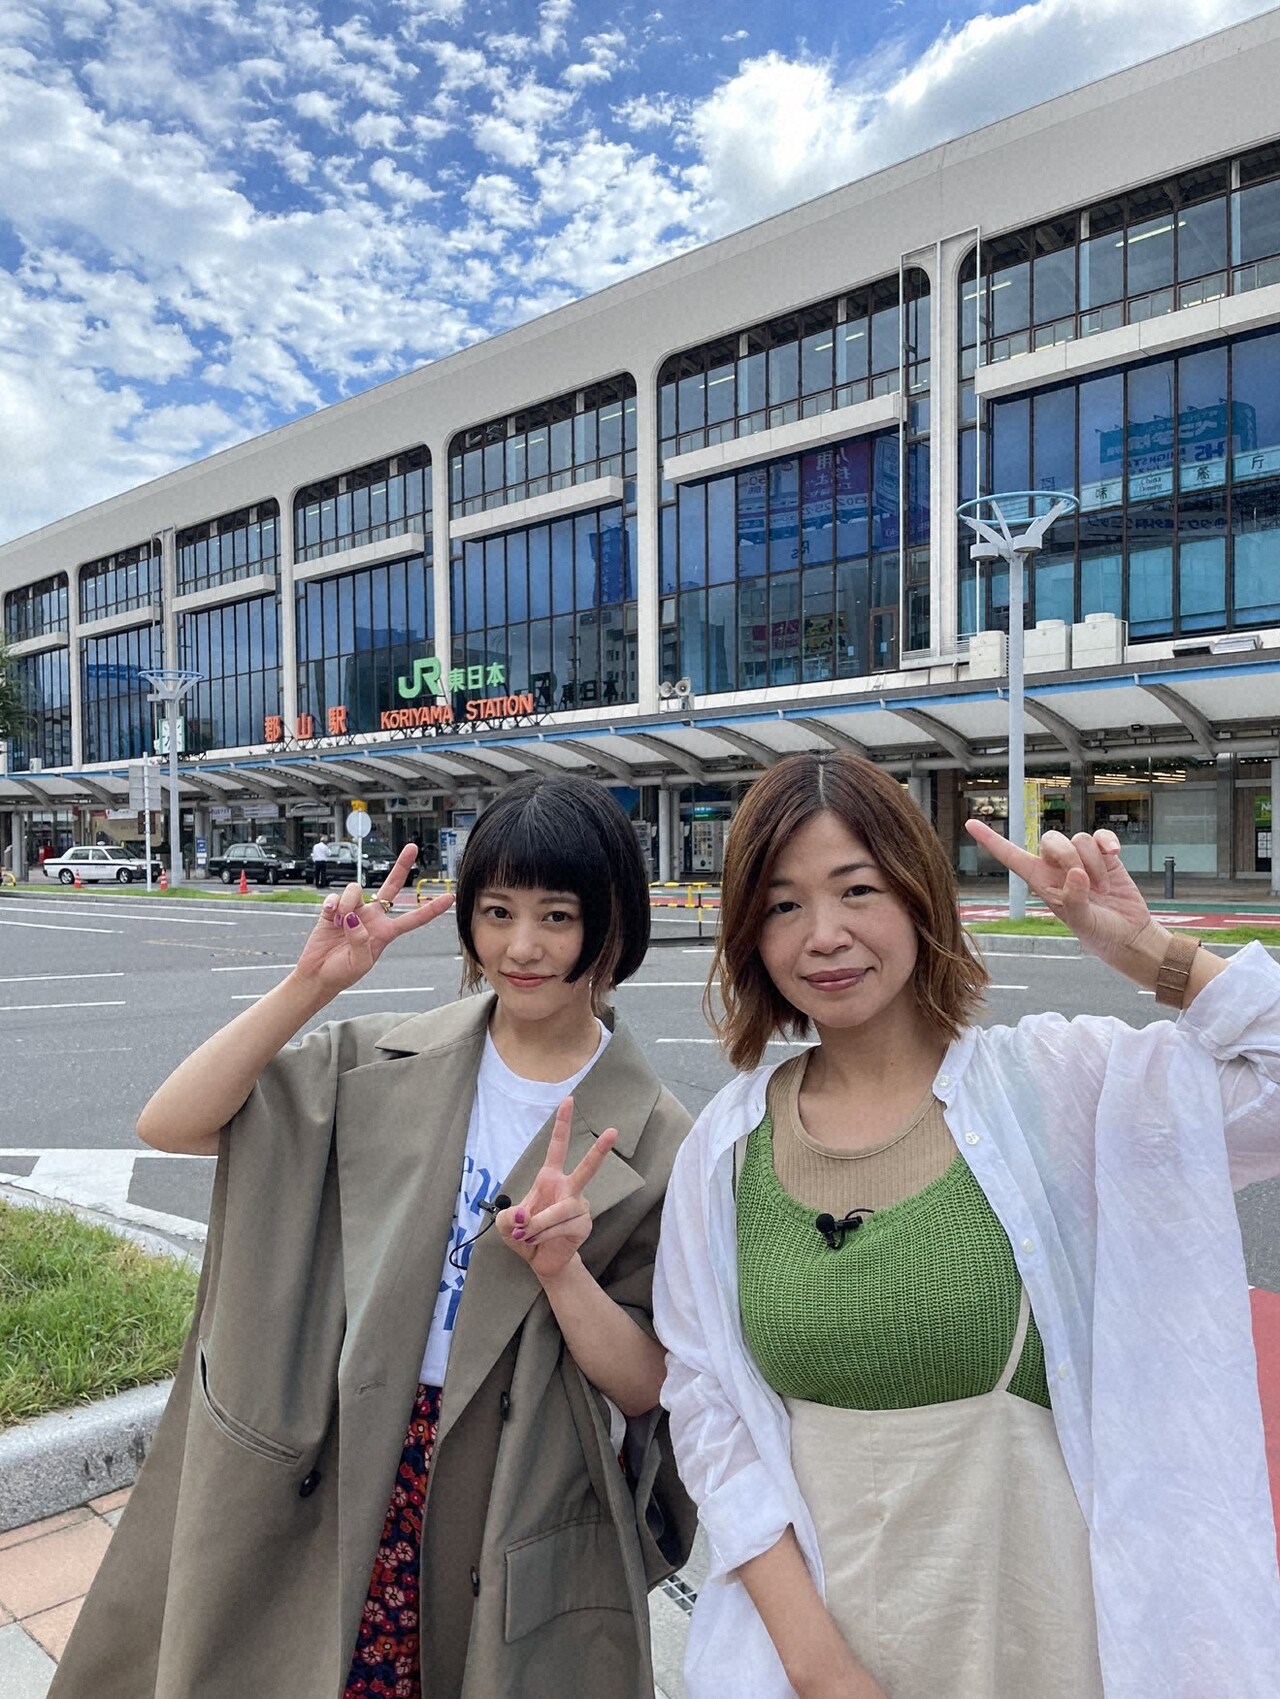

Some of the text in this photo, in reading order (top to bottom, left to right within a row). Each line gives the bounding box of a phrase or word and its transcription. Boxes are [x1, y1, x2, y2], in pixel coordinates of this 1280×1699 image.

[397, 656, 443, 699] JR
[448, 661, 506, 693] 東日本
[264, 704, 348, 743] 郡山駅
[465, 692, 535, 721] STATION
